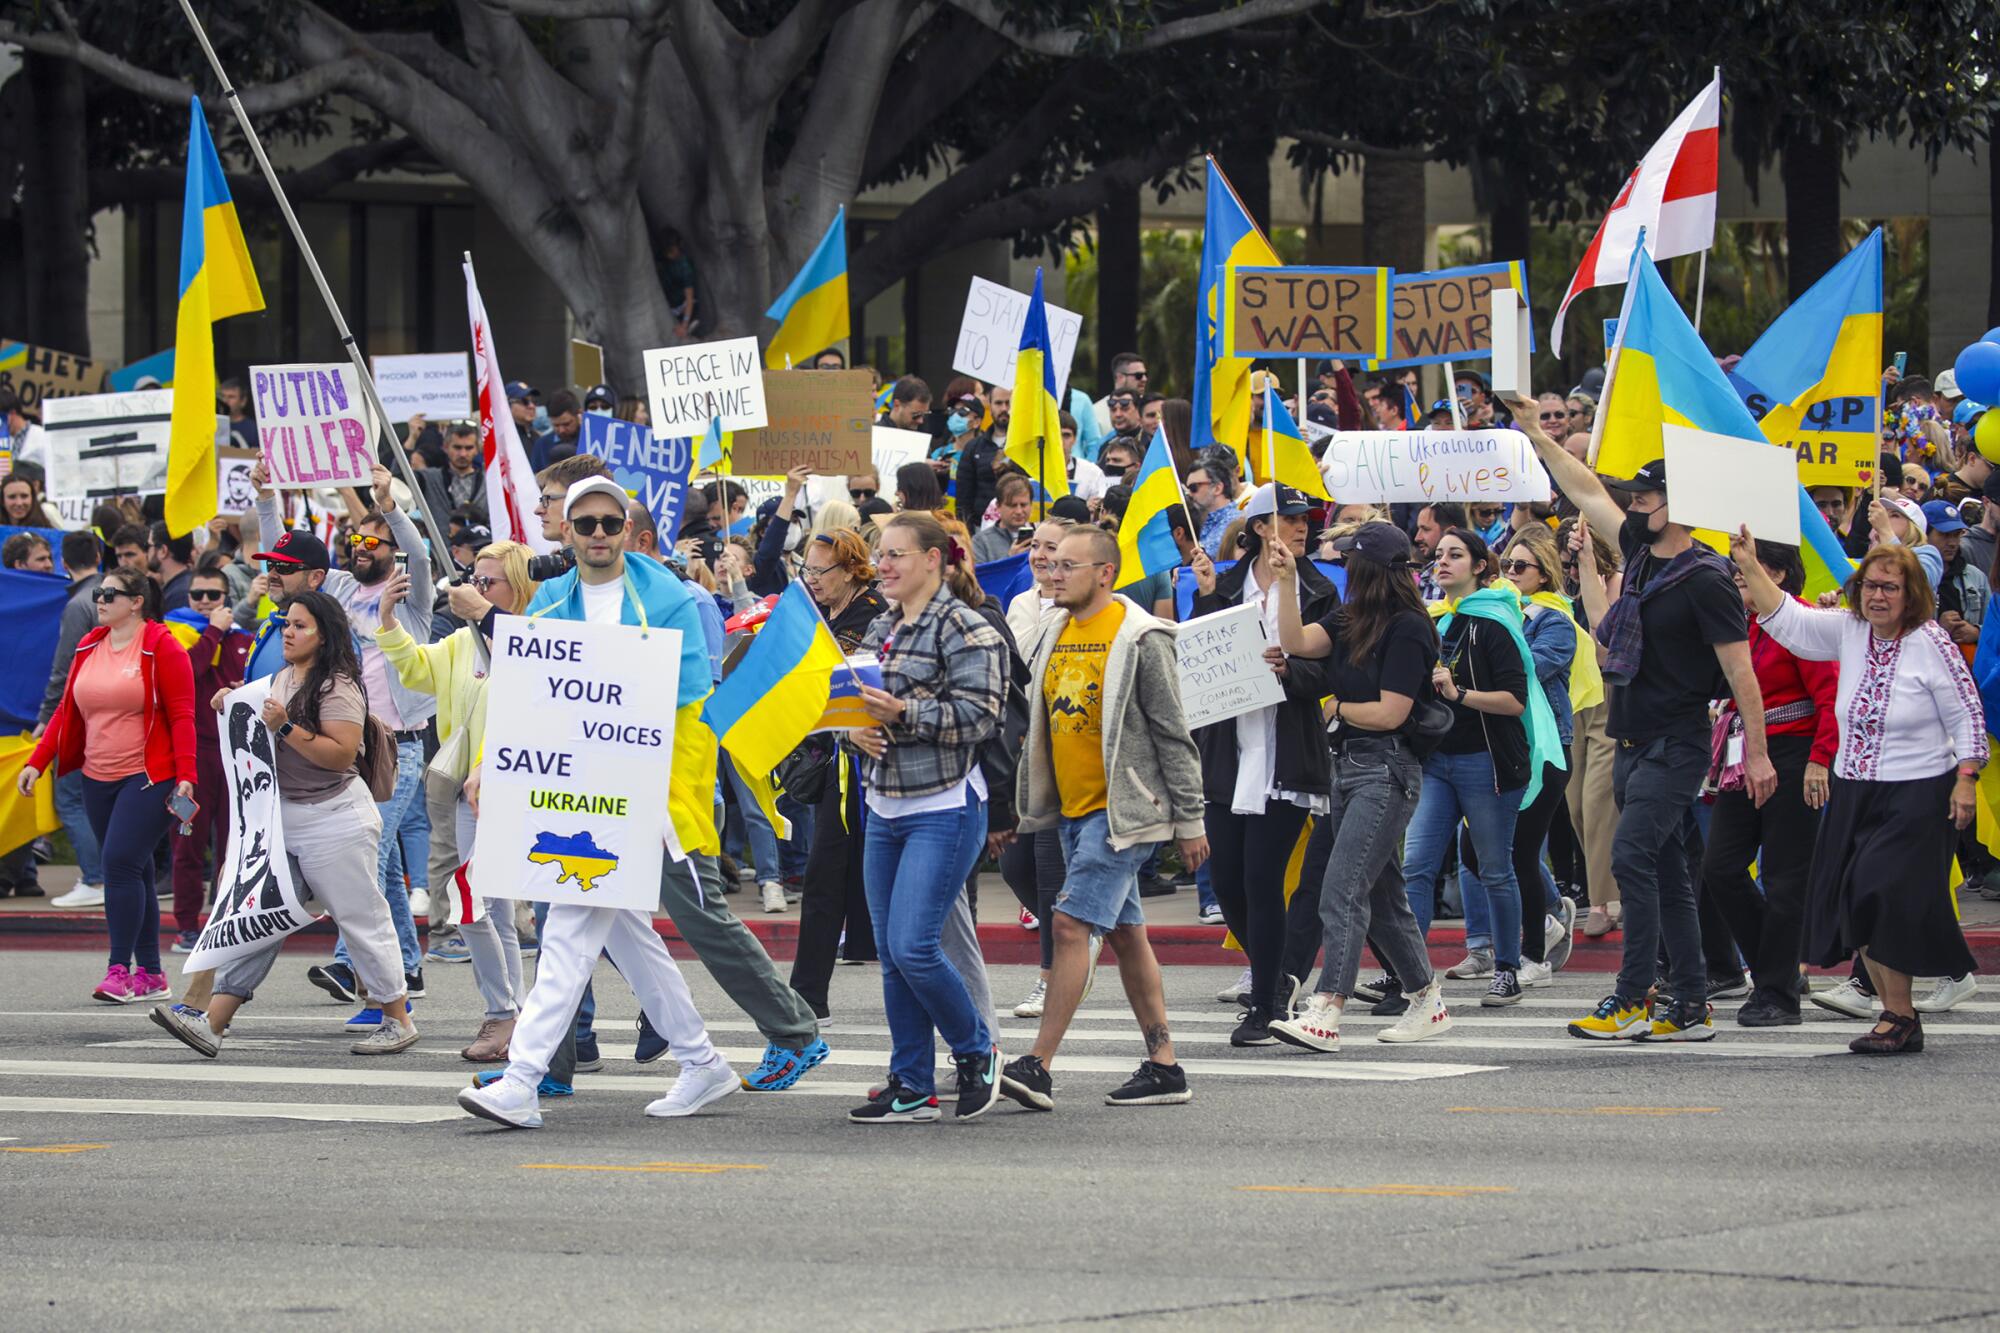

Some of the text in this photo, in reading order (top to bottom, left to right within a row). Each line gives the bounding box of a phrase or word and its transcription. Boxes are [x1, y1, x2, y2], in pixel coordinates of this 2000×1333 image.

[1242, 276, 1360, 312] STOP
[1393, 276, 1492, 321] STOP
[964, 328, 988, 370] TO
[1251, 313, 1362, 352] WAR
[1396, 313, 1492, 357] WAR
[25, 346, 93, 381] НЕТ
[660, 354, 723, 387] PEACE
[255, 368, 349, 418] PUTIN
[1746, 393, 1865, 425] SOP
[261, 418, 374, 483] KILLER
[584, 417, 687, 474] WE NEED
[760, 431, 832, 447] RUSSIAN
[1777, 440, 1838, 464] AR
[752, 449, 860, 471] IMPERIALISM
[1328, 435, 1498, 490] SAVE Ukrainian
[507, 635, 583, 662] RAISE
[548, 676, 622, 705] YOUR
[582, 720, 662, 747] VOICES
[496, 747, 573, 777] SAVE
[530, 790, 627, 816] UKRAINE
[238, 908, 299, 943] KAPUT
